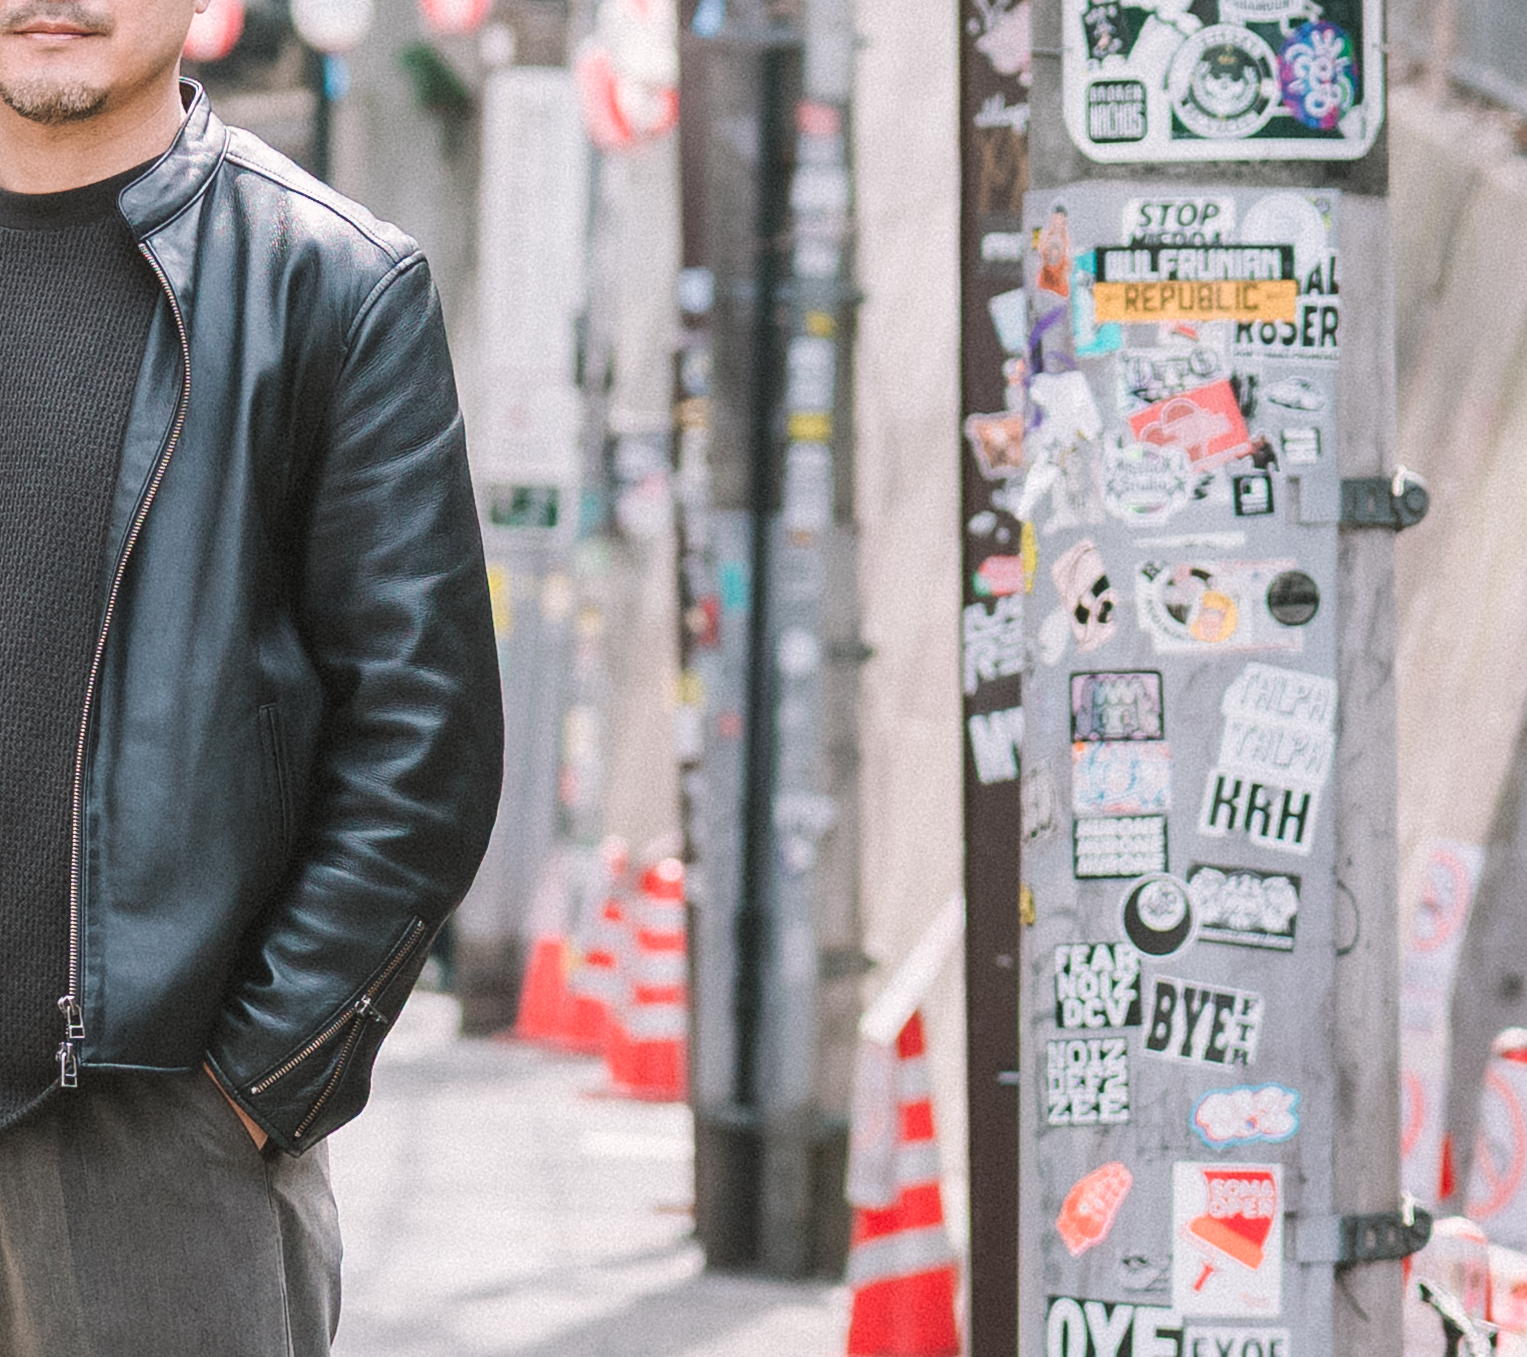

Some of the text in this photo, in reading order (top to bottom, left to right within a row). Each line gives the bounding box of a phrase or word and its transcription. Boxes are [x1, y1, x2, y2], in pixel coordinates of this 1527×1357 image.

[1138, 202, 1221, 228] STOP
[1124, 284, 1261, 312] REPUBLIC
[1058, 971, 1138, 1002] NOIZ
[1062, 998, 1132, 1030] DCV
[1145, 980, 1237, 1064] BYE
[1047, 1038, 1127, 1070] NOIZ
[1047, 1094, 1130, 1125] ZEE
